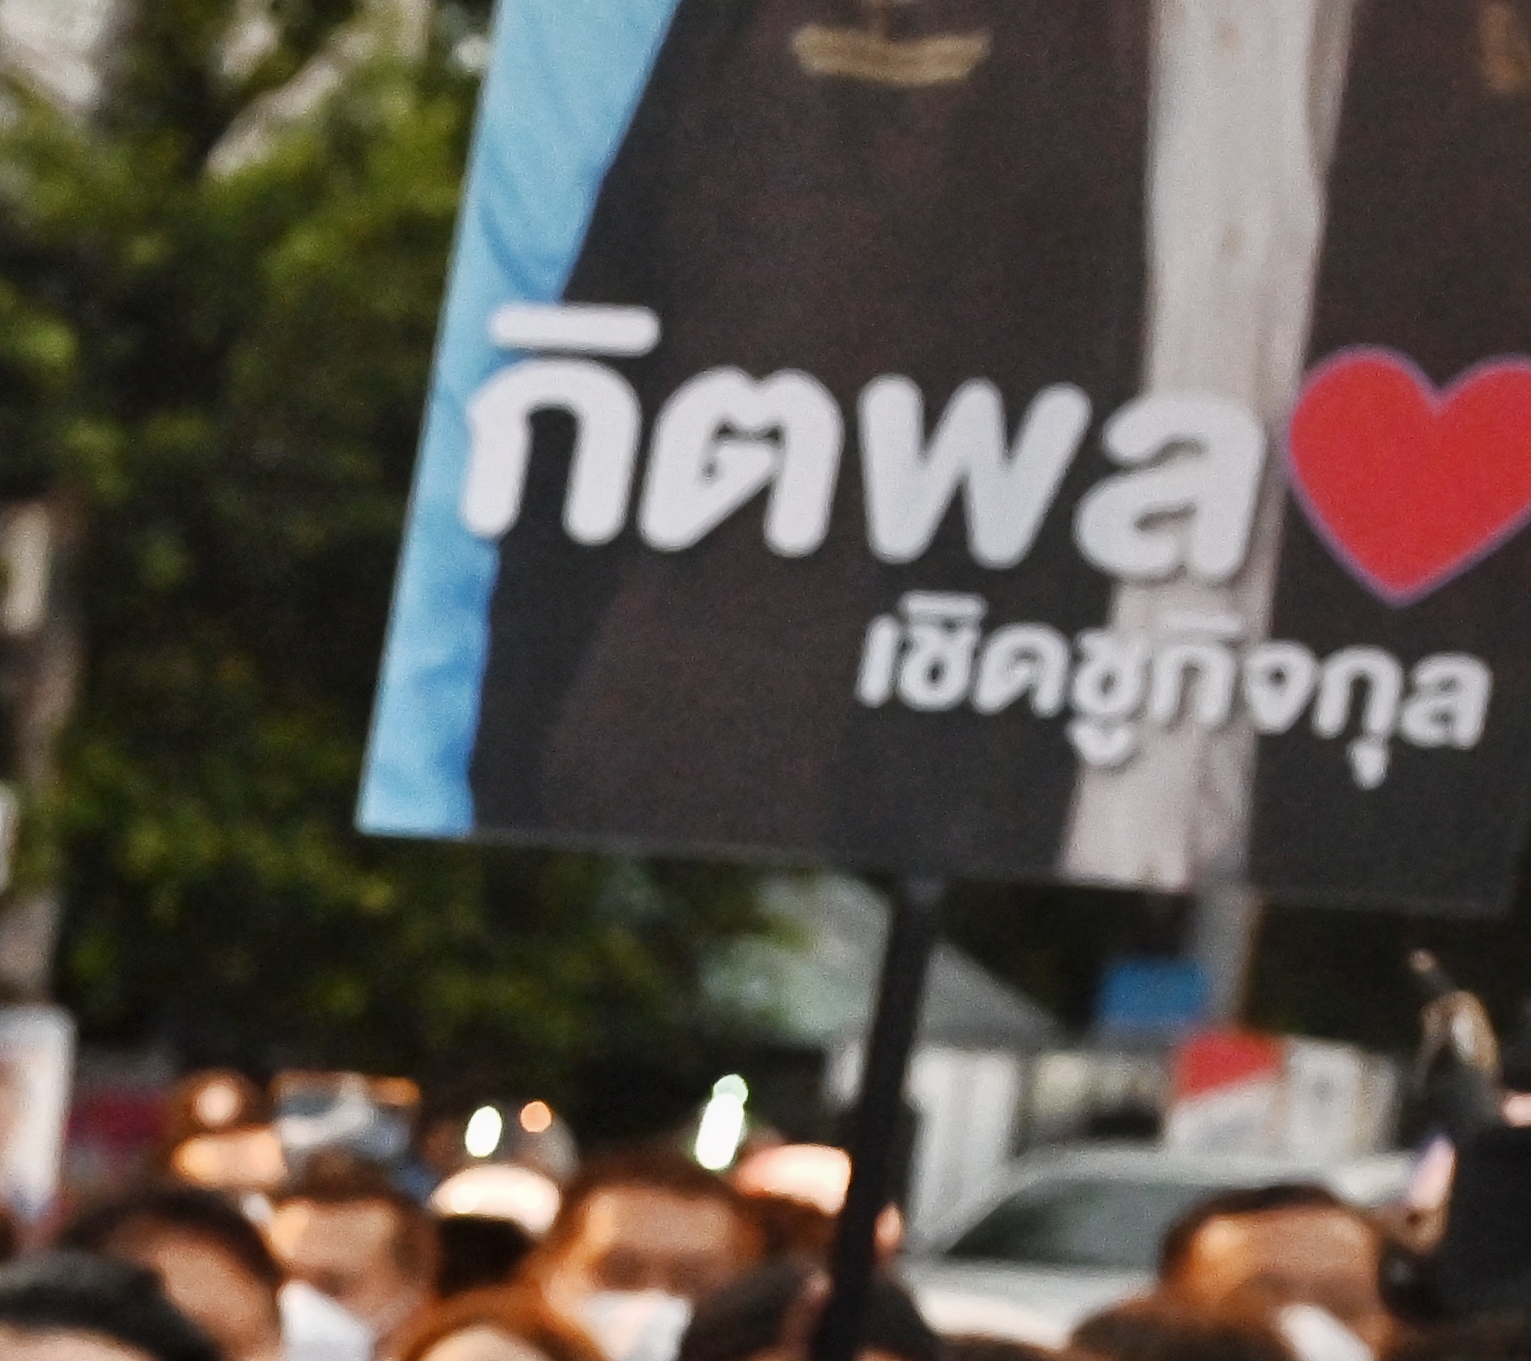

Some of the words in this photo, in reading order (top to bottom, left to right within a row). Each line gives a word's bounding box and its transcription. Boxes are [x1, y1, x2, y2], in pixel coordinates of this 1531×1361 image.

[460, 302, 1267, 582] กิตพล
[857, 592, 1494, 790] เชิดชูกิจกุล
